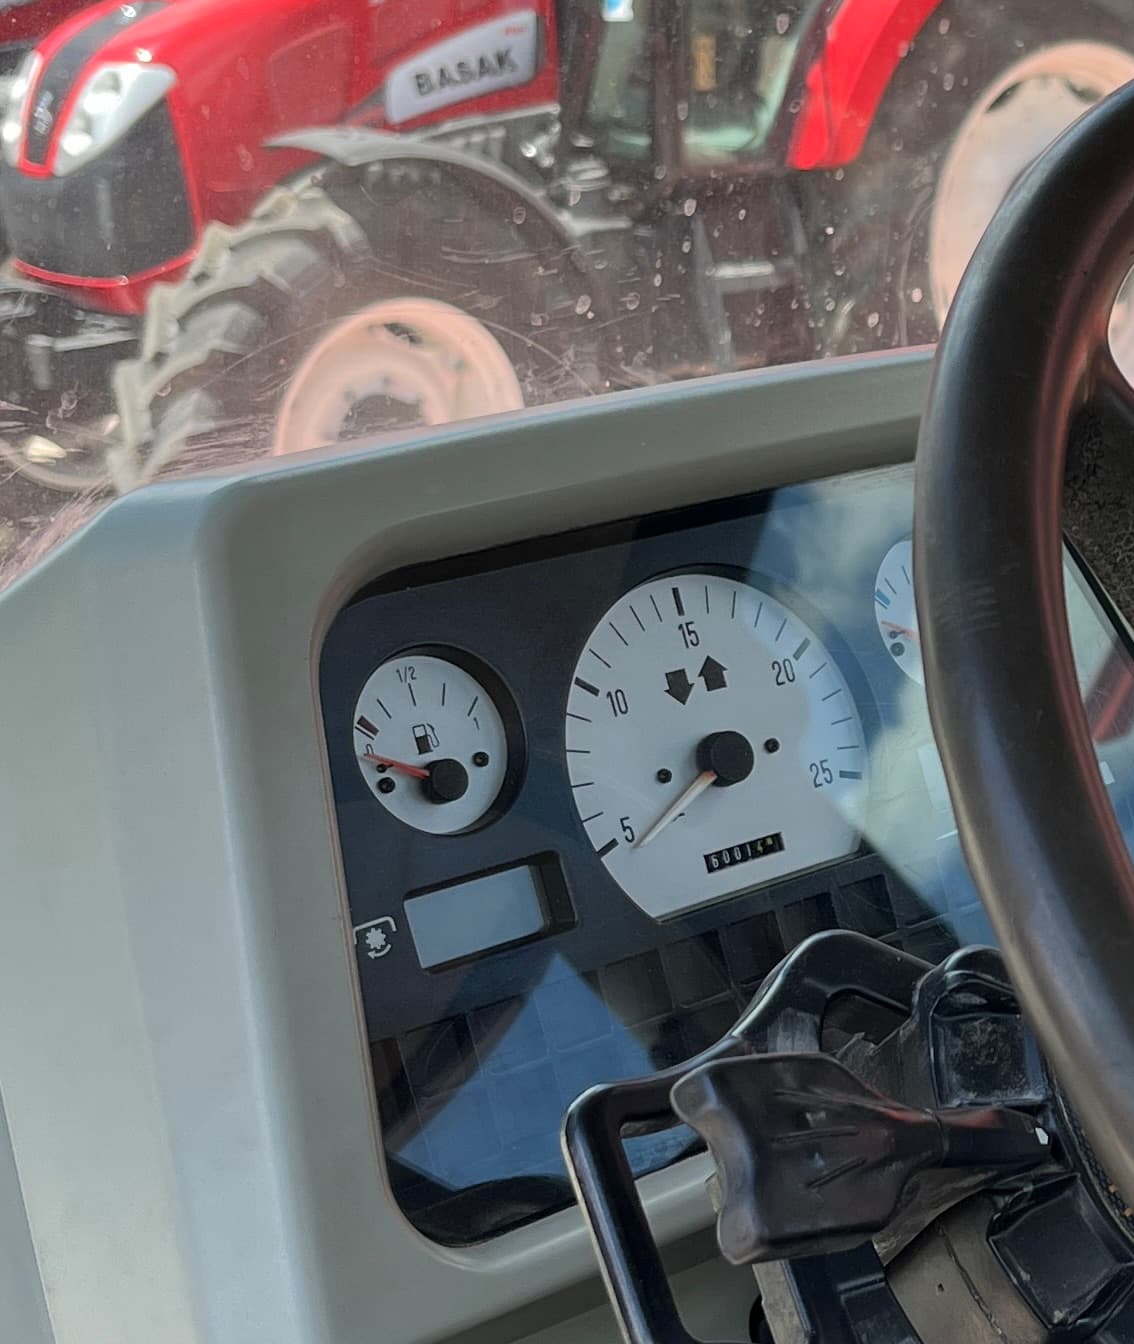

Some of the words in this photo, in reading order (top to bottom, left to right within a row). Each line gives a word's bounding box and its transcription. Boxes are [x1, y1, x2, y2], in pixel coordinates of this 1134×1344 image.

[414, 47, 519, 96] BASAK
[678, 621, 700, 649] 15
[396, 666, 417, 684] 1/2
[772, 658, 796, 687] 20
[606, 689, 629, 717] 10
[809, 759, 834, 788] 25
[619, 816, 636, 843] 5
